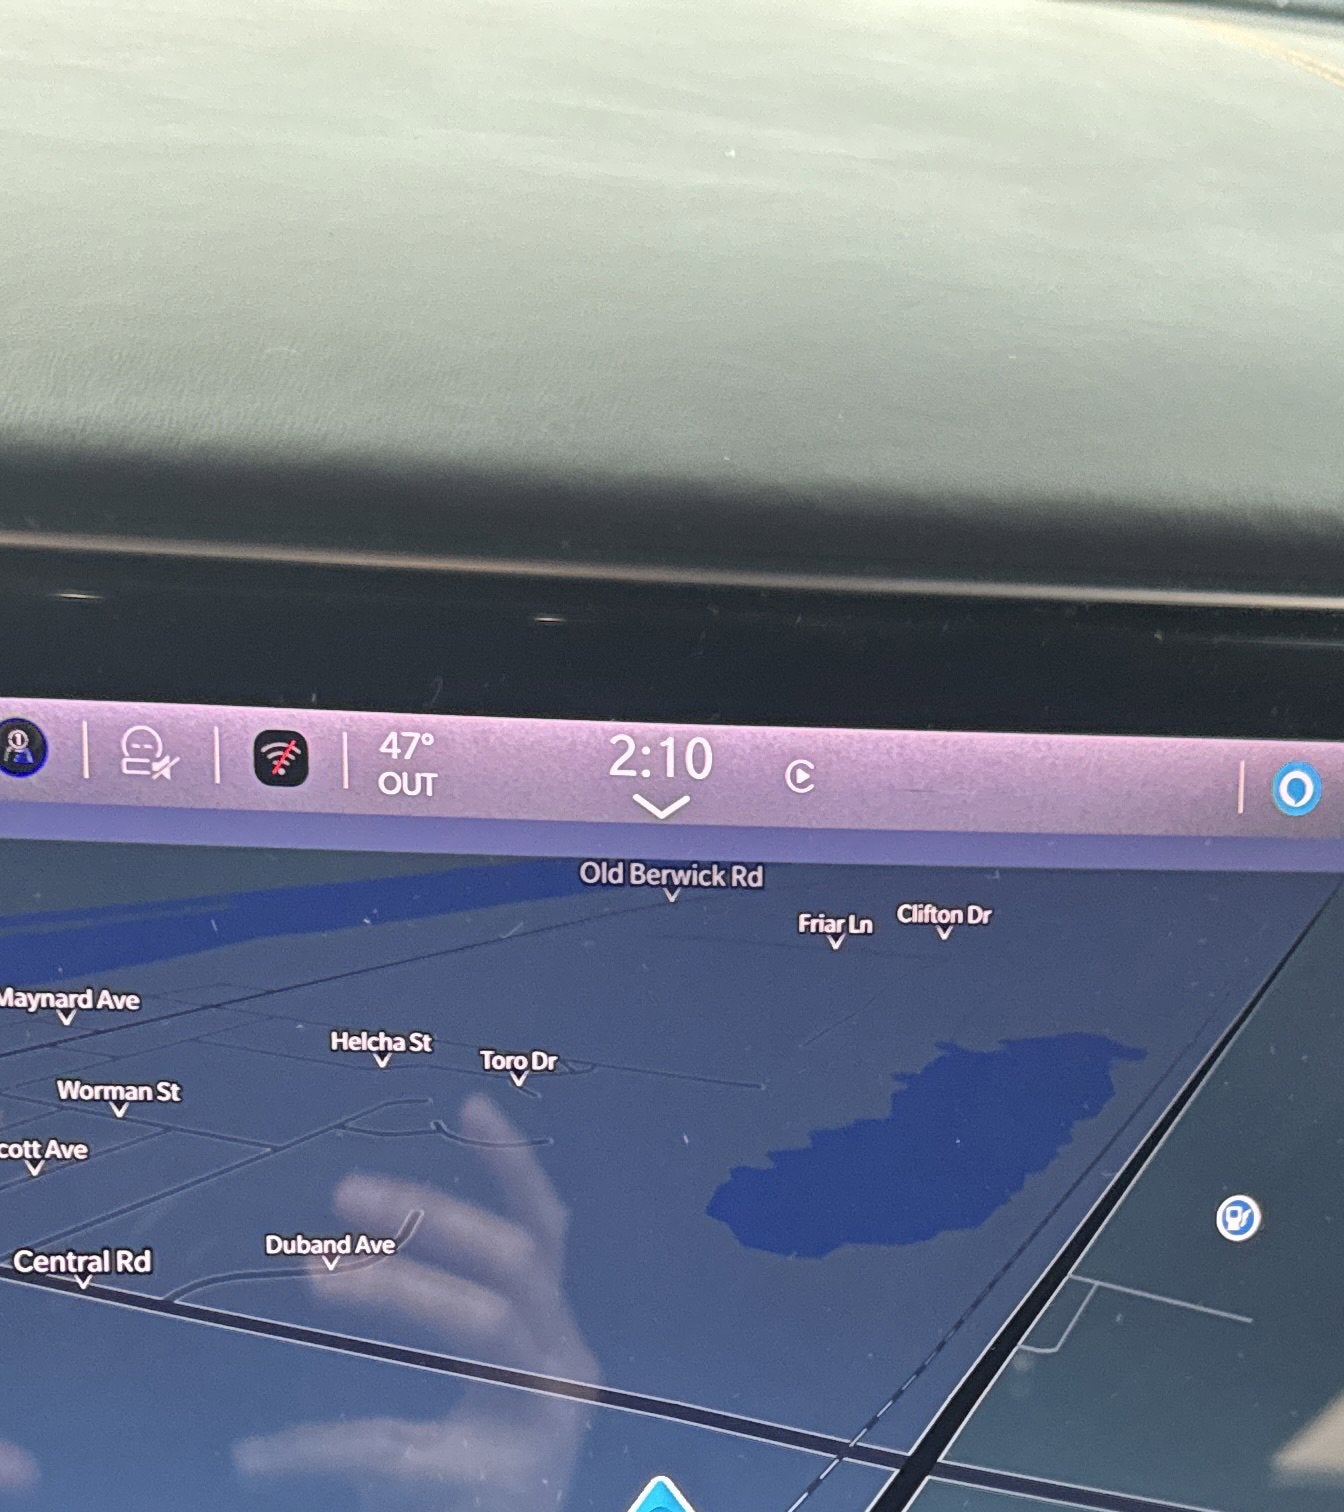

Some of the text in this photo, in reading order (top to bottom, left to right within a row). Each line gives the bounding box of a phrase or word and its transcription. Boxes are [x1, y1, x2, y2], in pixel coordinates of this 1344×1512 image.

[378, 731, 435, 760] 47°
[608, 733, 714, 780] 2:10
[377, 771, 439, 797] OUT
[579, 861, 764, 888] Old Berwick Rd
[798, 914, 873, 935] Friar Ln
[897, 903, 992, 925] Clifton Dr
[96, 989, 141, 1010] Ave
[330, 1031, 433, 1052] Helcha St
[480, 1050, 558, 1071] Toro Dr
[56, 1080, 182, 1102] Worman St
[44, 1139, 89, 1160] Ave
[265, 1234, 396, 1255] Duband Ave
[13, 1249, 152, 1273] Central Rd
